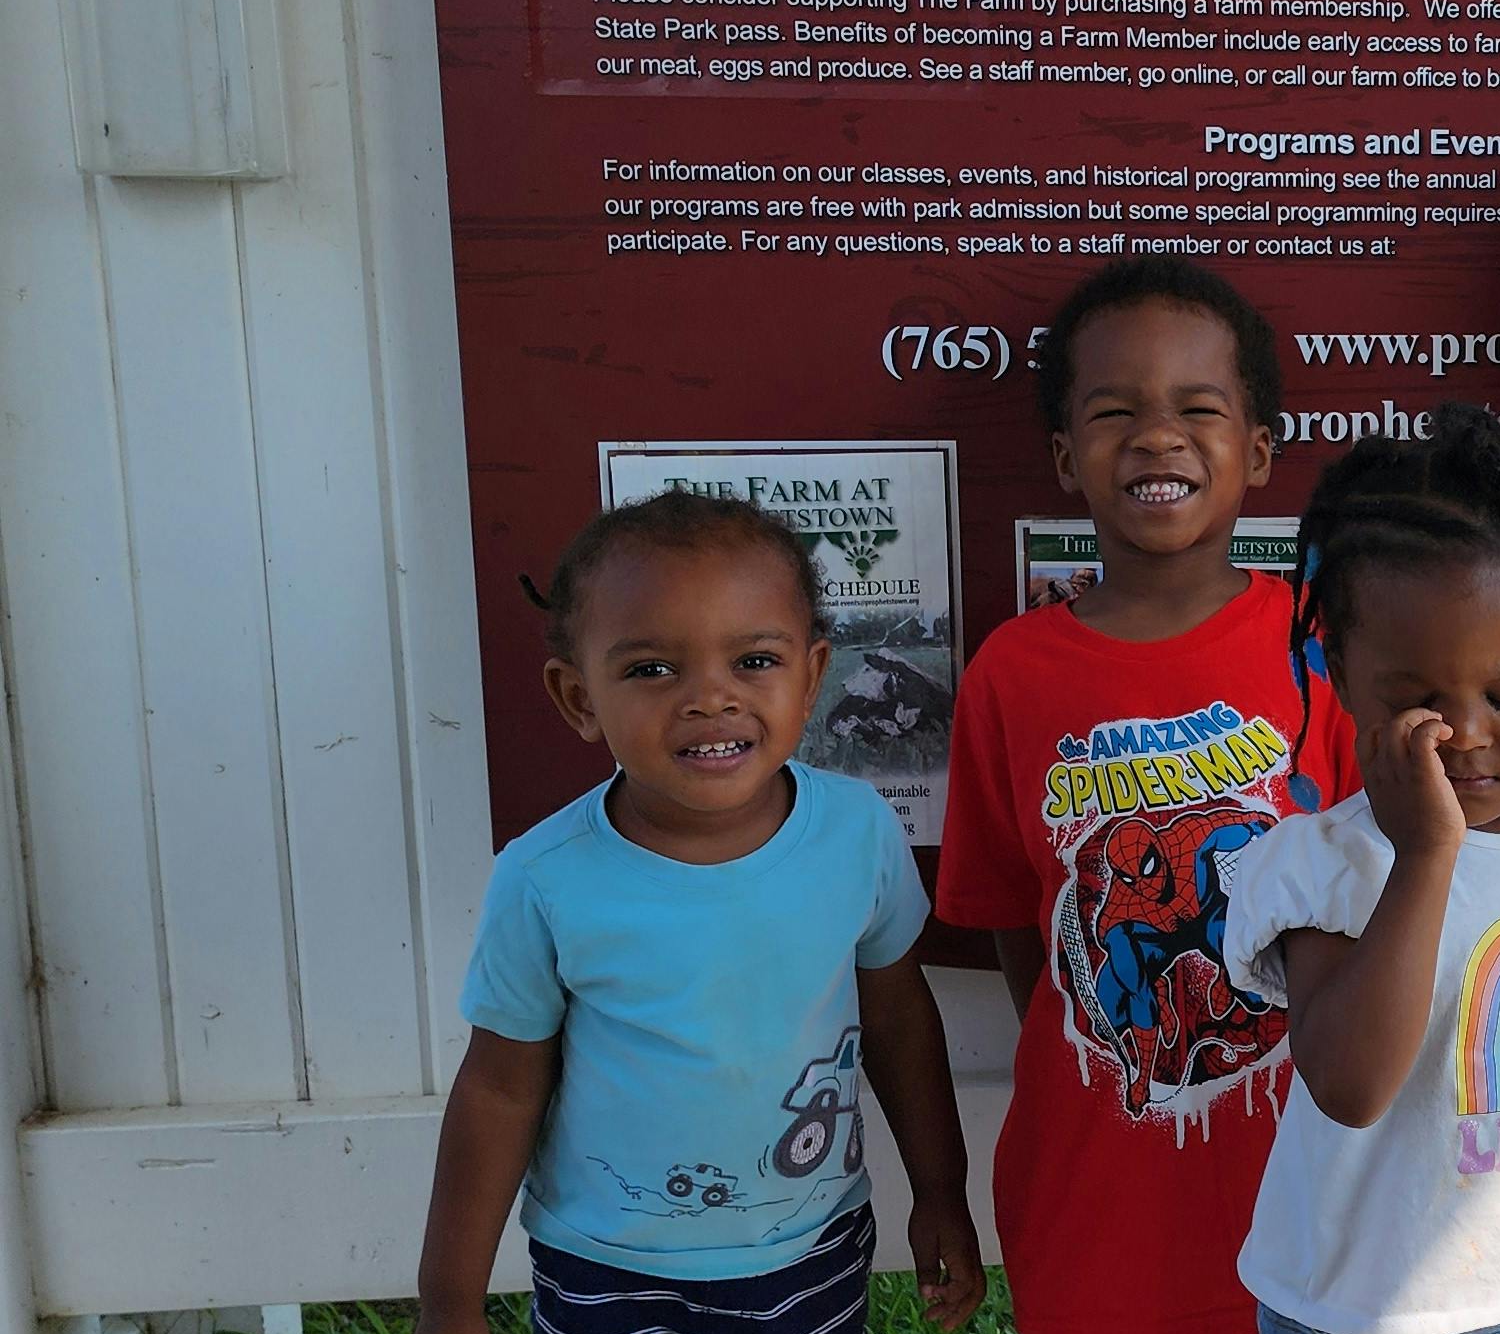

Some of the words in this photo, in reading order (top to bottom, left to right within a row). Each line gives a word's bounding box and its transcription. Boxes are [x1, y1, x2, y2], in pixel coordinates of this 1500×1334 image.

[596, 57, 635, 74] our
[640, 54, 702, 79] meat,
[708, 59, 764, 81] eggs
[769, 55, 811, 77] and
[817, 56, 913, 82] produce.
[919, 57, 963, 80] See
[968, 63, 983, 80] a
[988, 59, 1035, 81] staff
[1039, 61, 1132, 86] member,
[1138, 66, 1166, 88] go
[1170, 62, 1239, 88] online,
[1245, 68, 1268, 85] or
[1271, 64, 1306, 86] call
[1311, 69, 1347, 86] our
[1350, 65, 1397, 87] farm
[1402, 66, 1457, 87] office
[1461, 67, 1482, 88] to
[1205, 126, 1355, 161] Programs
[1364, 128, 1420, 155] and
[604, 199, 644, 215] our
[650, 199, 760, 221] programs
[766, 200, 804, 217] are
[809, 195, 855, 217] free
[860, 196, 906, 218] with
[913, 197, 963, 223] park
[969, 198, 1081, 220] admission
[1088, 199, 1123, 220] but
[1128, 204, 1189, 221] some
[1195, 200, 1270, 226] special
[1277, 201, 1417, 227] programming
[882, 325, 1010, 381] (765)
[745, 476, 841, 502] FARM
[850, 477, 891, 501] AT
[1058, 535, 1096, 553] THE
[1090, 702, 1242, 761] AMAZING
